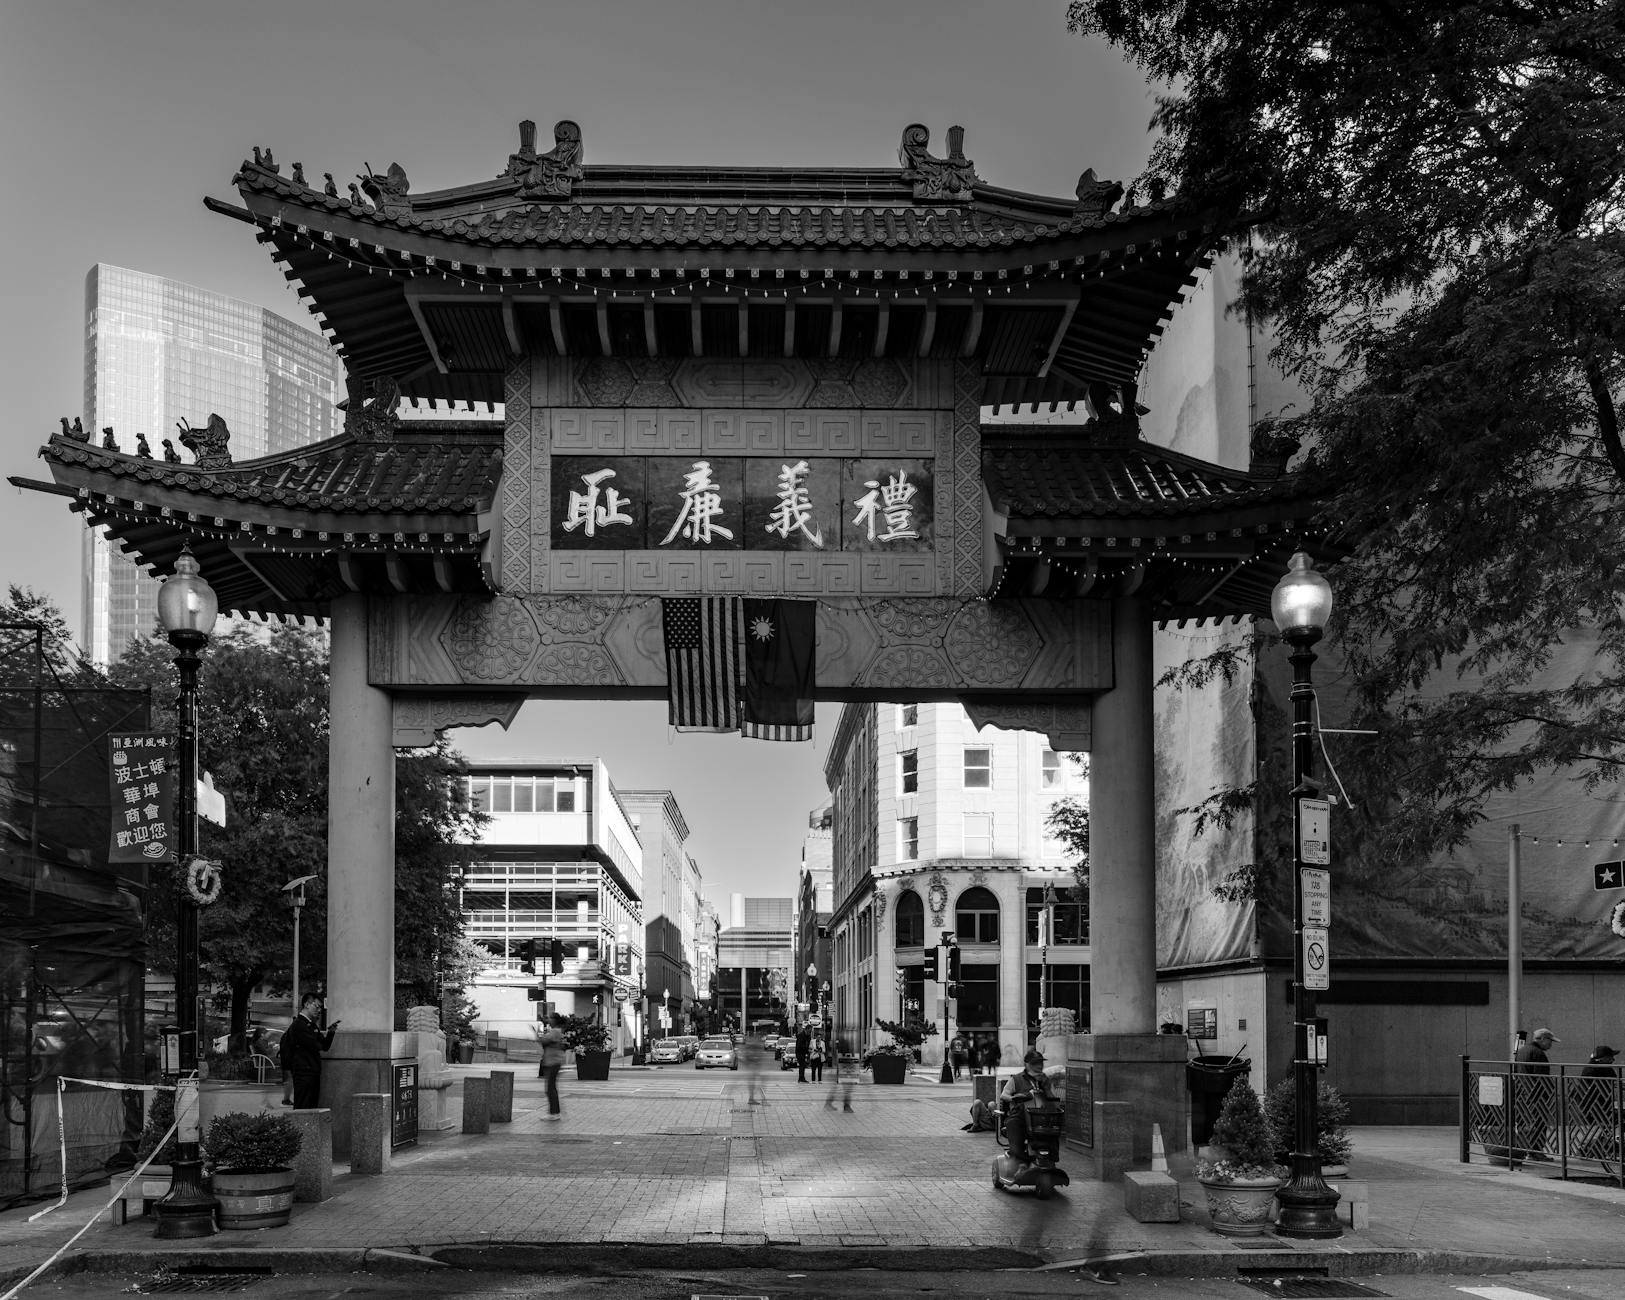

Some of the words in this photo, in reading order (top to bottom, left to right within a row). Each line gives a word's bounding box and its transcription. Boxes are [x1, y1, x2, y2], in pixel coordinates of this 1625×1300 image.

[114, 757, 167, 784] 波士頓
[122, 782, 160, 804] 華埠
[124, 803, 161, 826] 商會
[116, 822, 168, 848] 歡迎您
[617, 923, 628, 964] PARK
